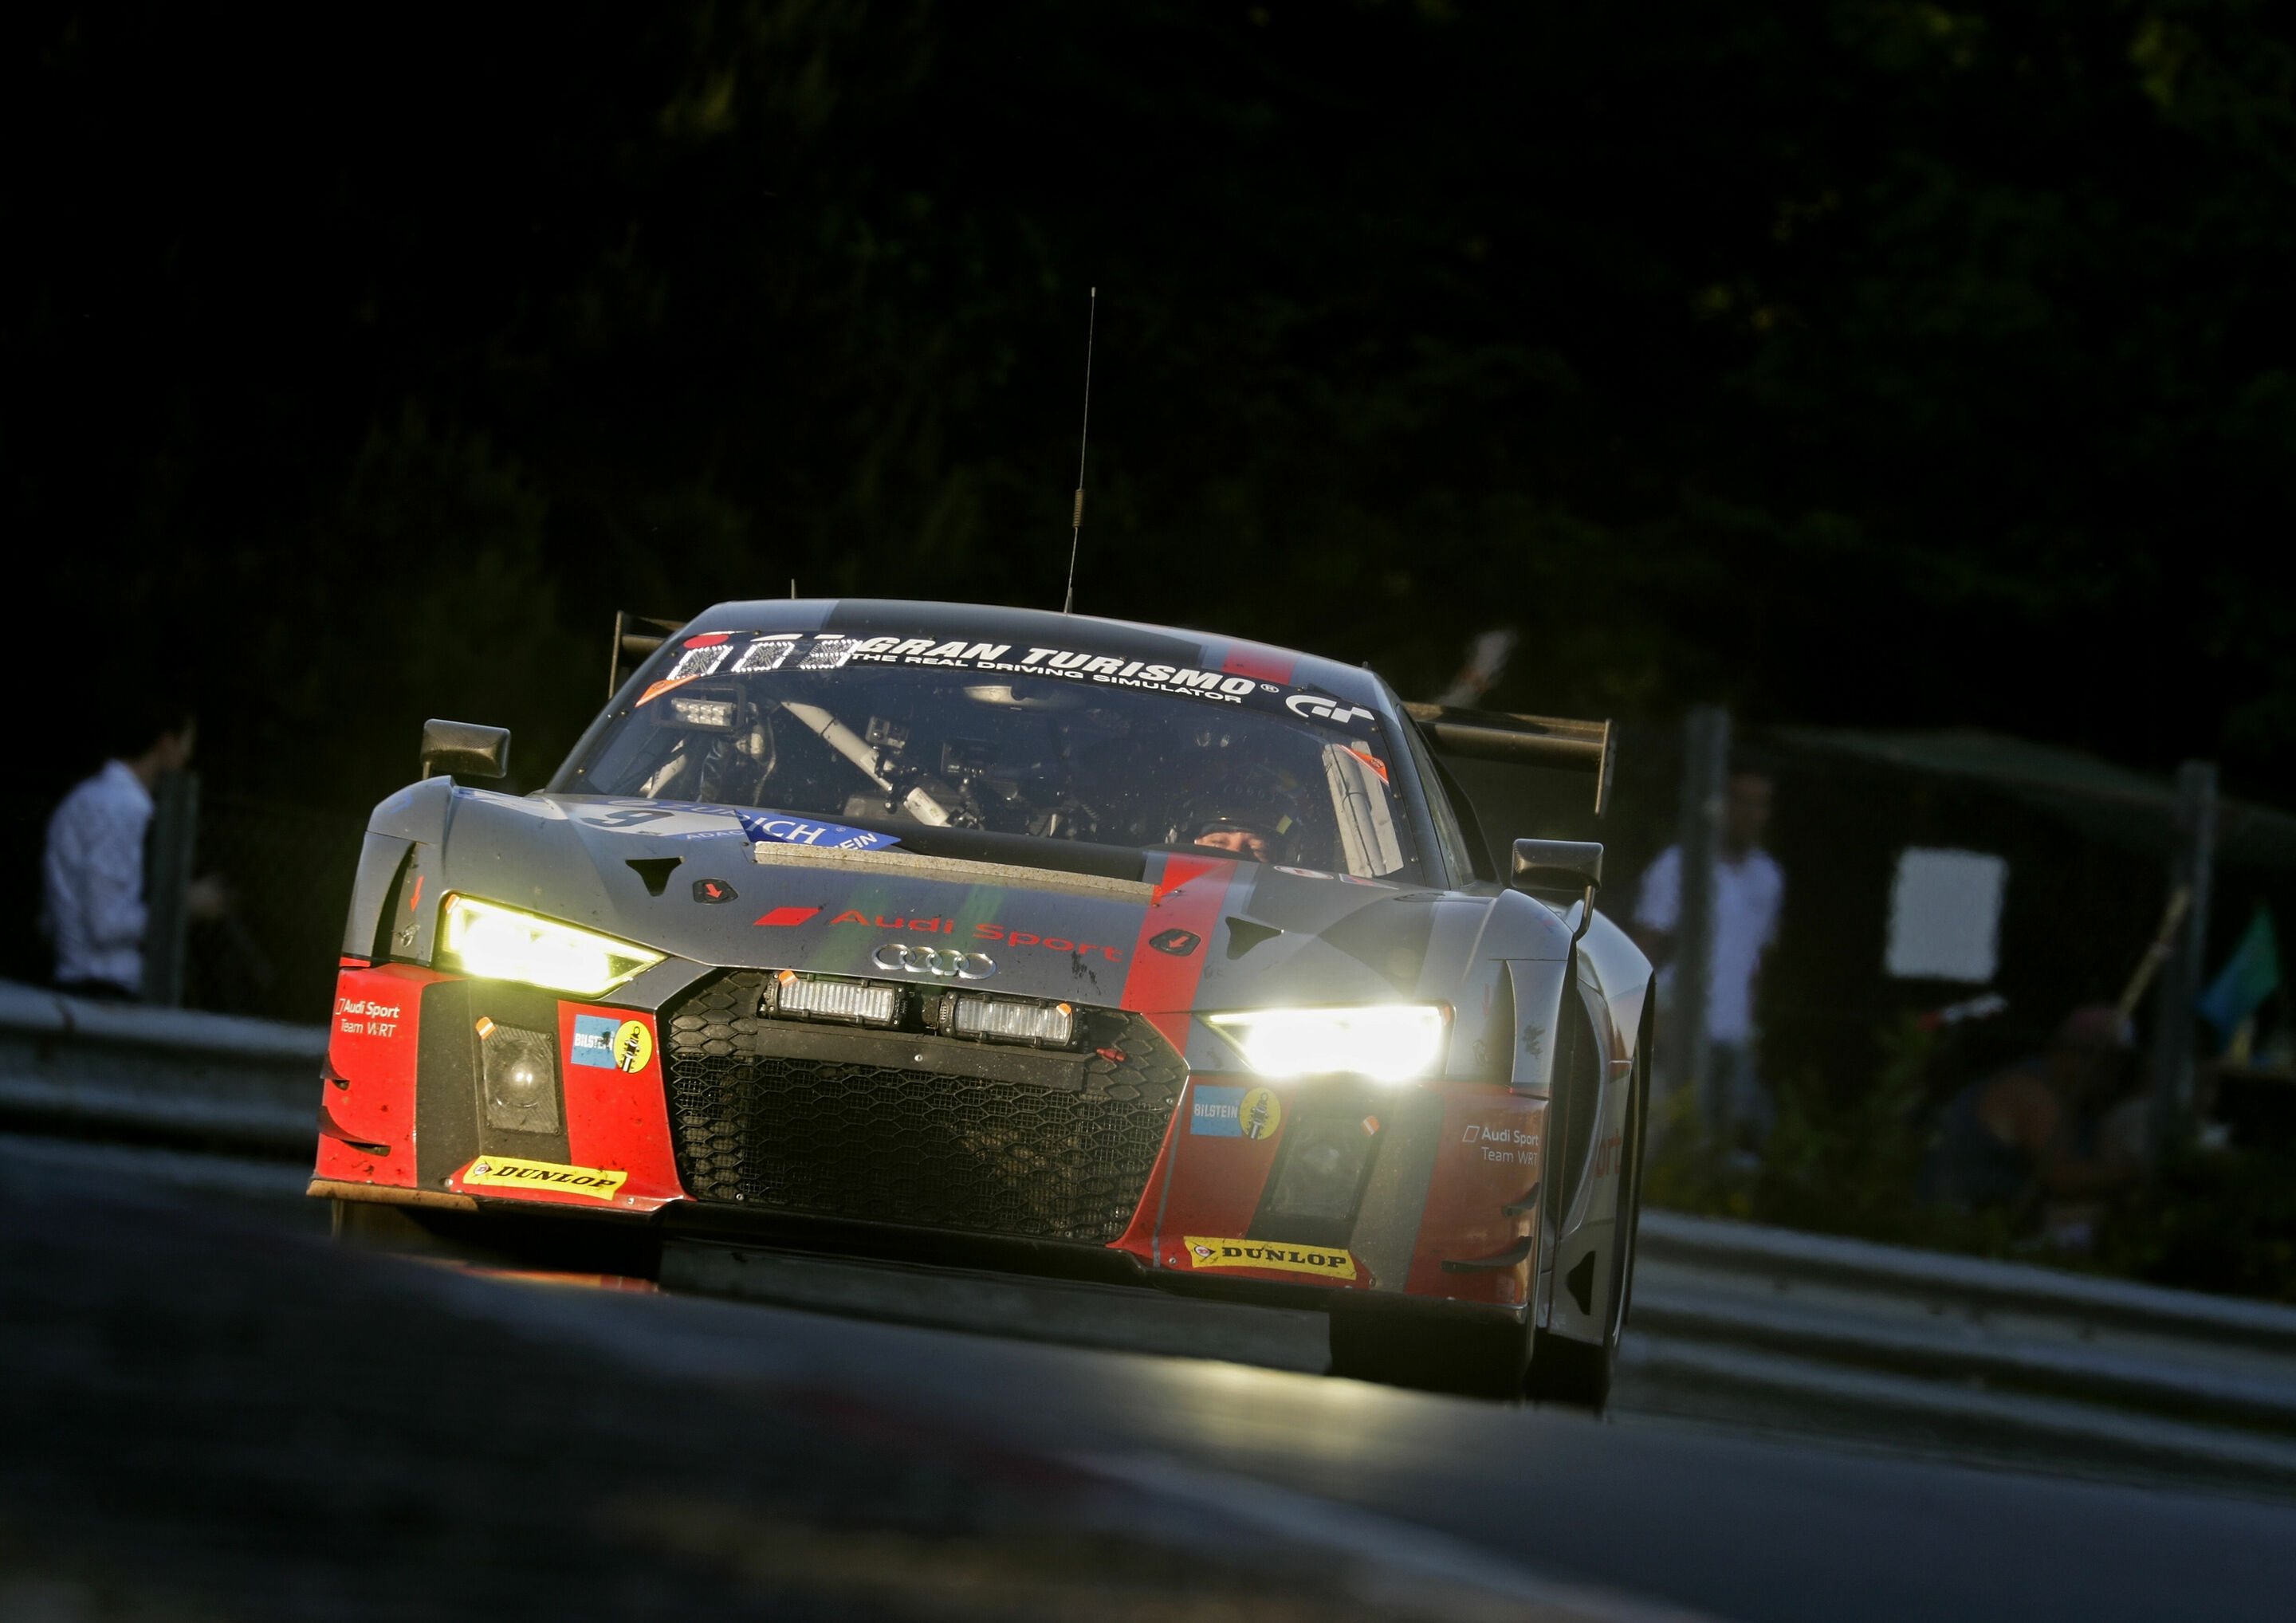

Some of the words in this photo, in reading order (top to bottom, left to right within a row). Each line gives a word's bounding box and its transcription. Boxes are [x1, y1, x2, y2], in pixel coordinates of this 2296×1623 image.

[856, 637, 1012, 661] GRAN
[1021, 647, 1256, 696] TURISMO
[852, 653, 898, 662] THE
[904, 656, 969, 667] REAL
[977, 661, 1084, 679] DRIVING
[1092, 674, 1243, 704] SIMULATOR
[686, 830, 746, 840] ADAC
[829, 909, 955, 934] Audi
[972, 922, 1124, 963] Sport
[343, 999, 367, 1015] Audi
[366, 1001, 400, 1019] Sport
[340, 1018, 364, 1035] Team
[367, 1022, 397, 1038] WRT
[1193, 1102, 1239, 1118] BILSTEIN
[1481, 1126, 1511, 1142] Audi
[1513, 1130, 1539, 1147] Sport
[1480, 1146, 1515, 1163] Team
[1517, 1149, 1539, 1167] WRT
[493, 1165, 617, 1188] DUNLOP
[1221, 1246, 1347, 1268] DUNLOP
